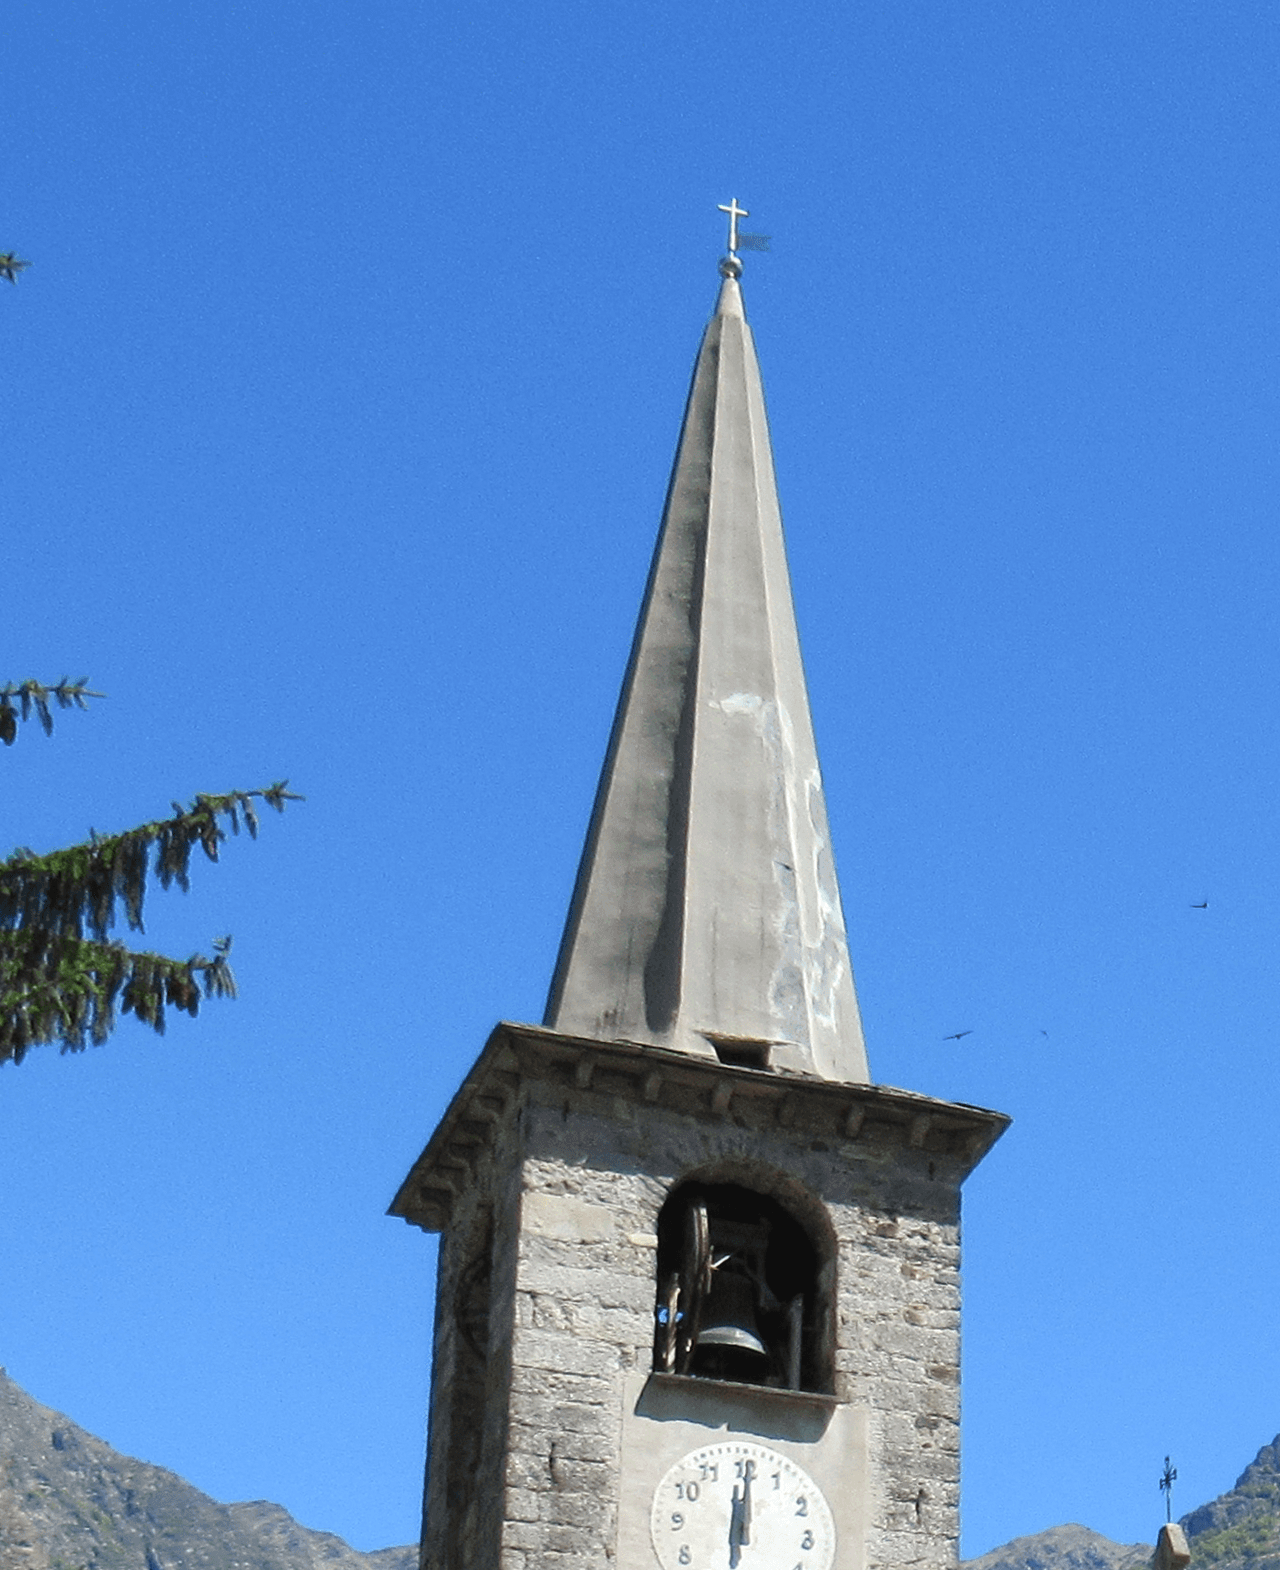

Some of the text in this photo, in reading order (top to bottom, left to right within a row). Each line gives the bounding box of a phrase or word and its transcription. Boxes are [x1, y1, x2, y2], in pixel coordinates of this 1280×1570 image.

[699, 1462, 720, 1482] 11
[734, 1458, 757, 1481] 12
[770, 1471, 781, 1490] 1
[675, 1481, 700, 1502] 10
[794, 1495, 808, 1518] 2
[670, 1511, 684, 1532] 9
[801, 1529, 815, 1551] 3
[678, 1544, 692, 1566] 8
